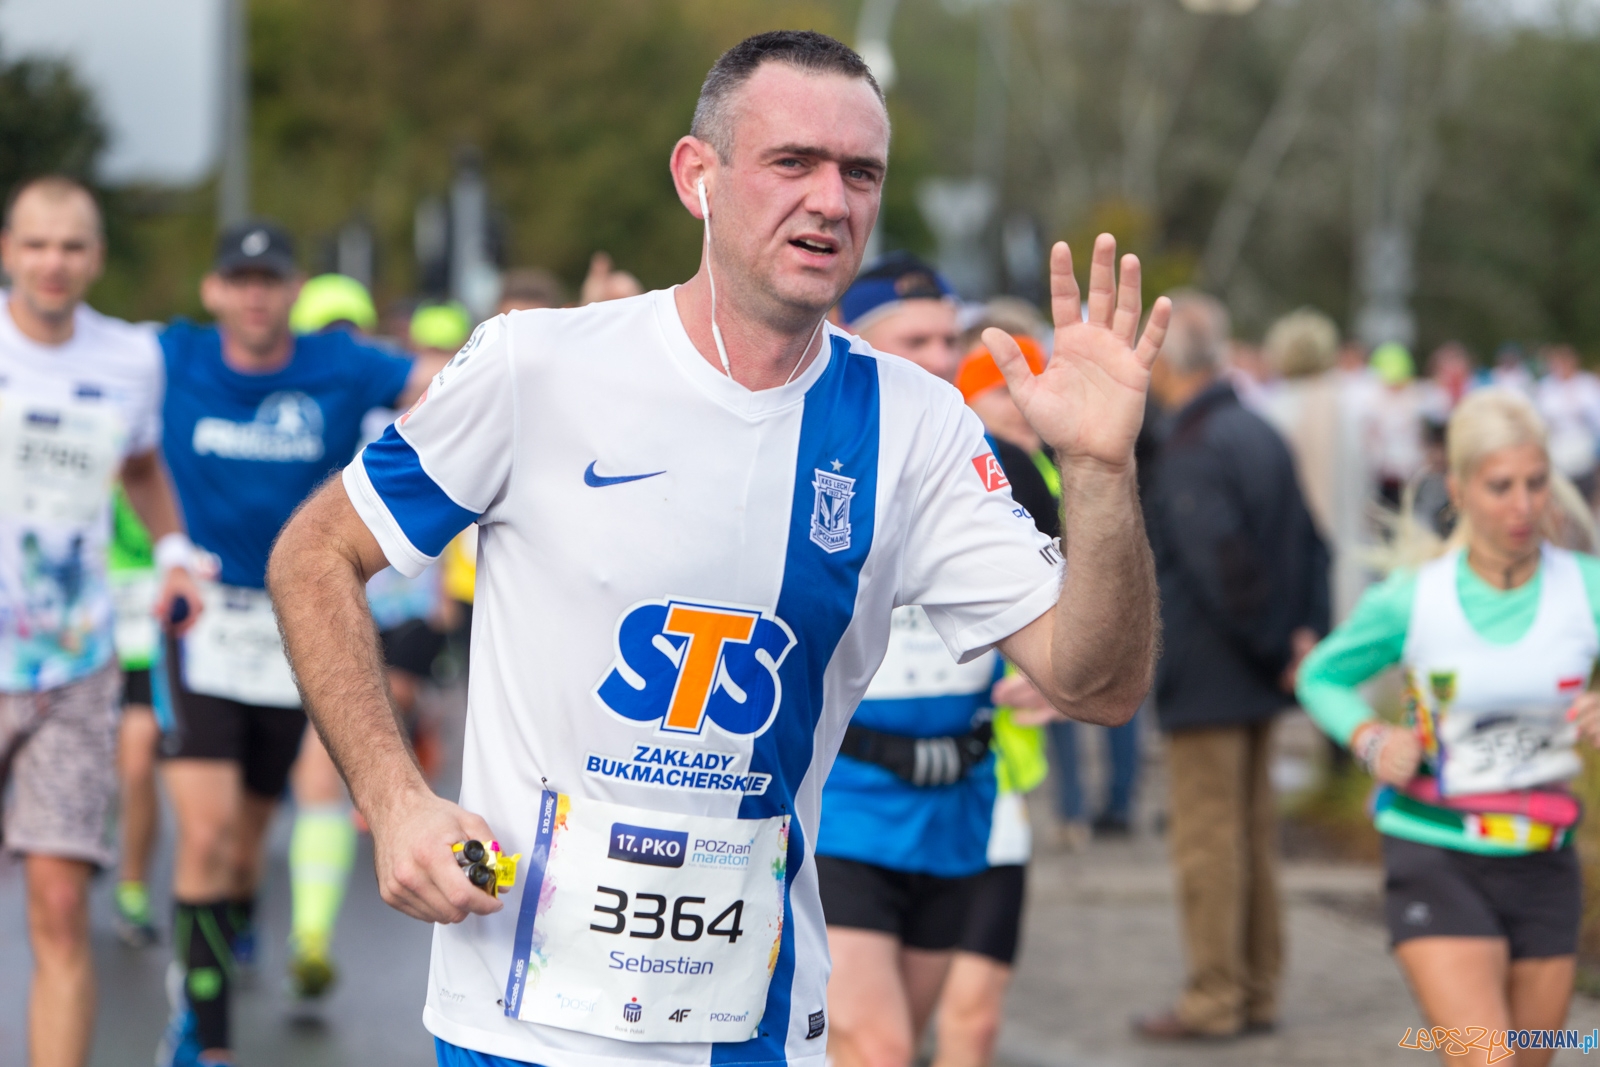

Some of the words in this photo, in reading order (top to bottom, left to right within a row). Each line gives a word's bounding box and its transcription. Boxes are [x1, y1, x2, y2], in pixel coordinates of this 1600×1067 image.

[821, 478, 832, 488] KKS
[833, 481, 848, 491] LECH
[597, 599, 796, 736] STS
[633, 745, 735, 771] ZAKŁADY
[586, 755, 767, 792] BUKMACHERSKIE
[616, 833, 638, 853] 17.
[640, 837, 681, 858] PKO
[691, 852, 750, 866] maraton
[589, 885, 744, 944] 3364
[608, 950, 714, 975] Sebastian
[668, 1009, 692, 1023] 4F
